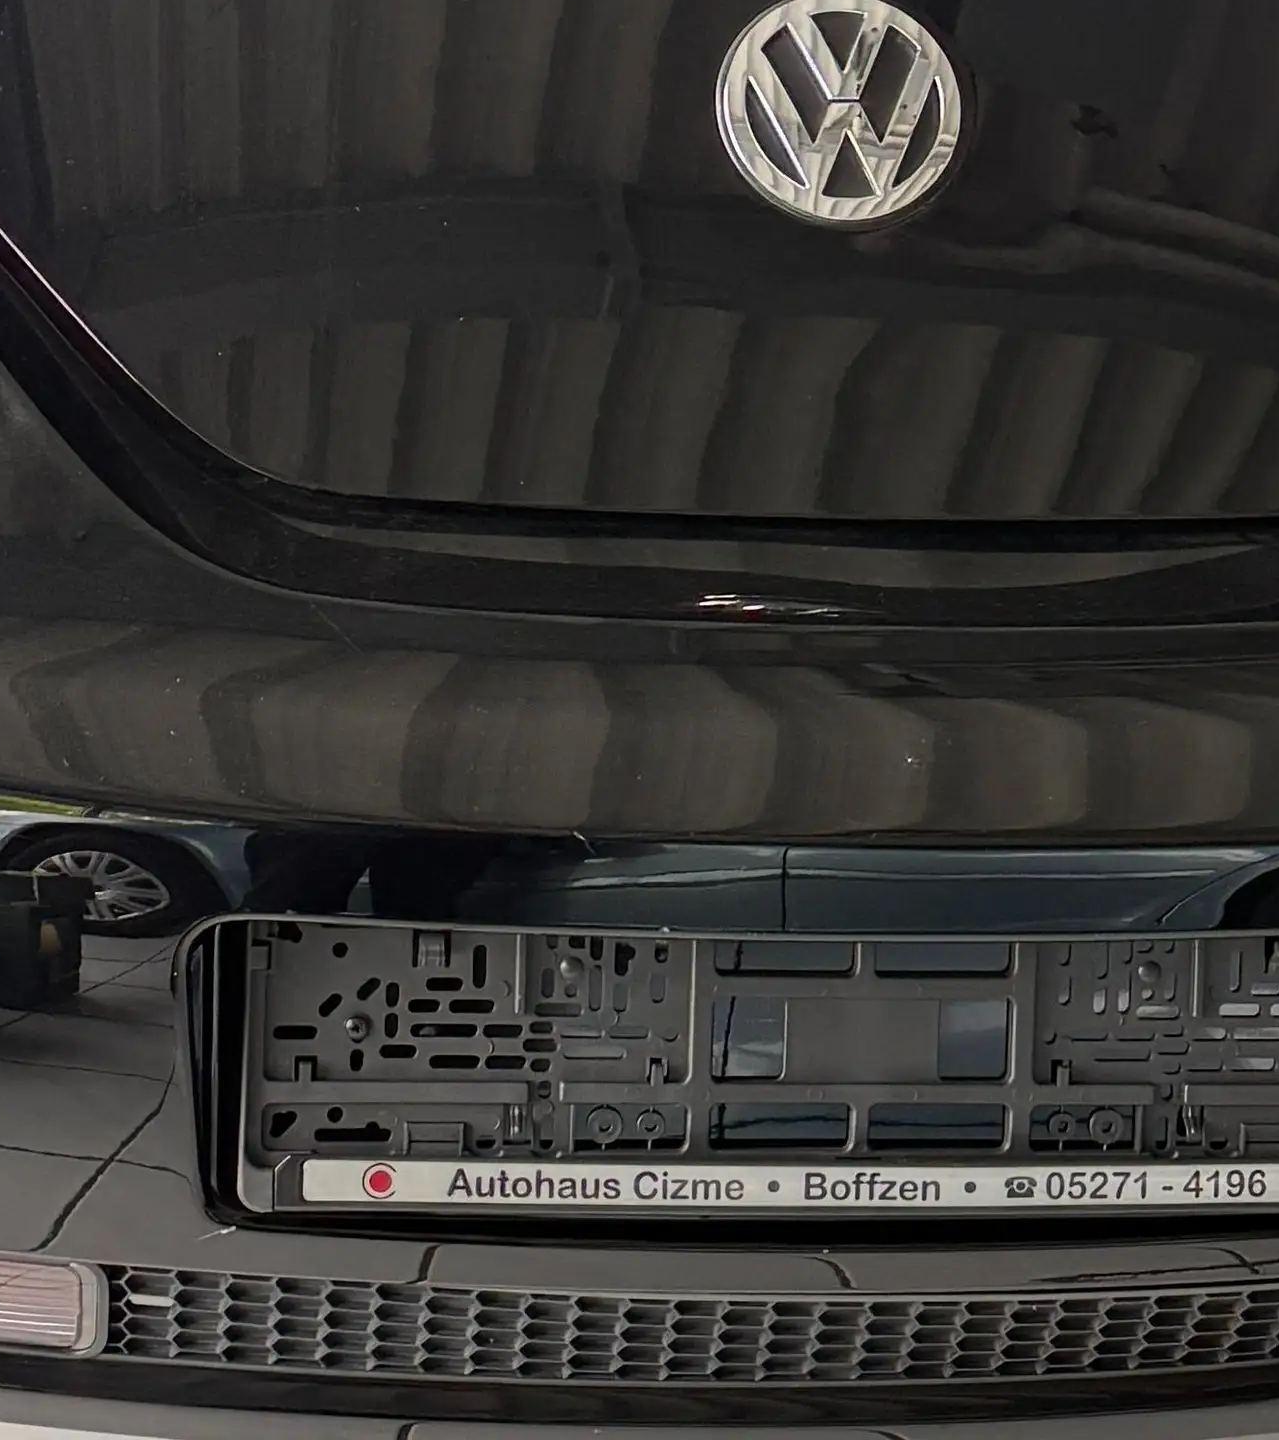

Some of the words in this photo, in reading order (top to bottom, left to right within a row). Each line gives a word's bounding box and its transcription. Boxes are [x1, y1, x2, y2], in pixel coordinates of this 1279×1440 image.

[447, 1168, 621, 1200] Autohaus
[633, 1170, 745, 1201] Cizme
[804, 1172, 941, 1202] Boffzen
